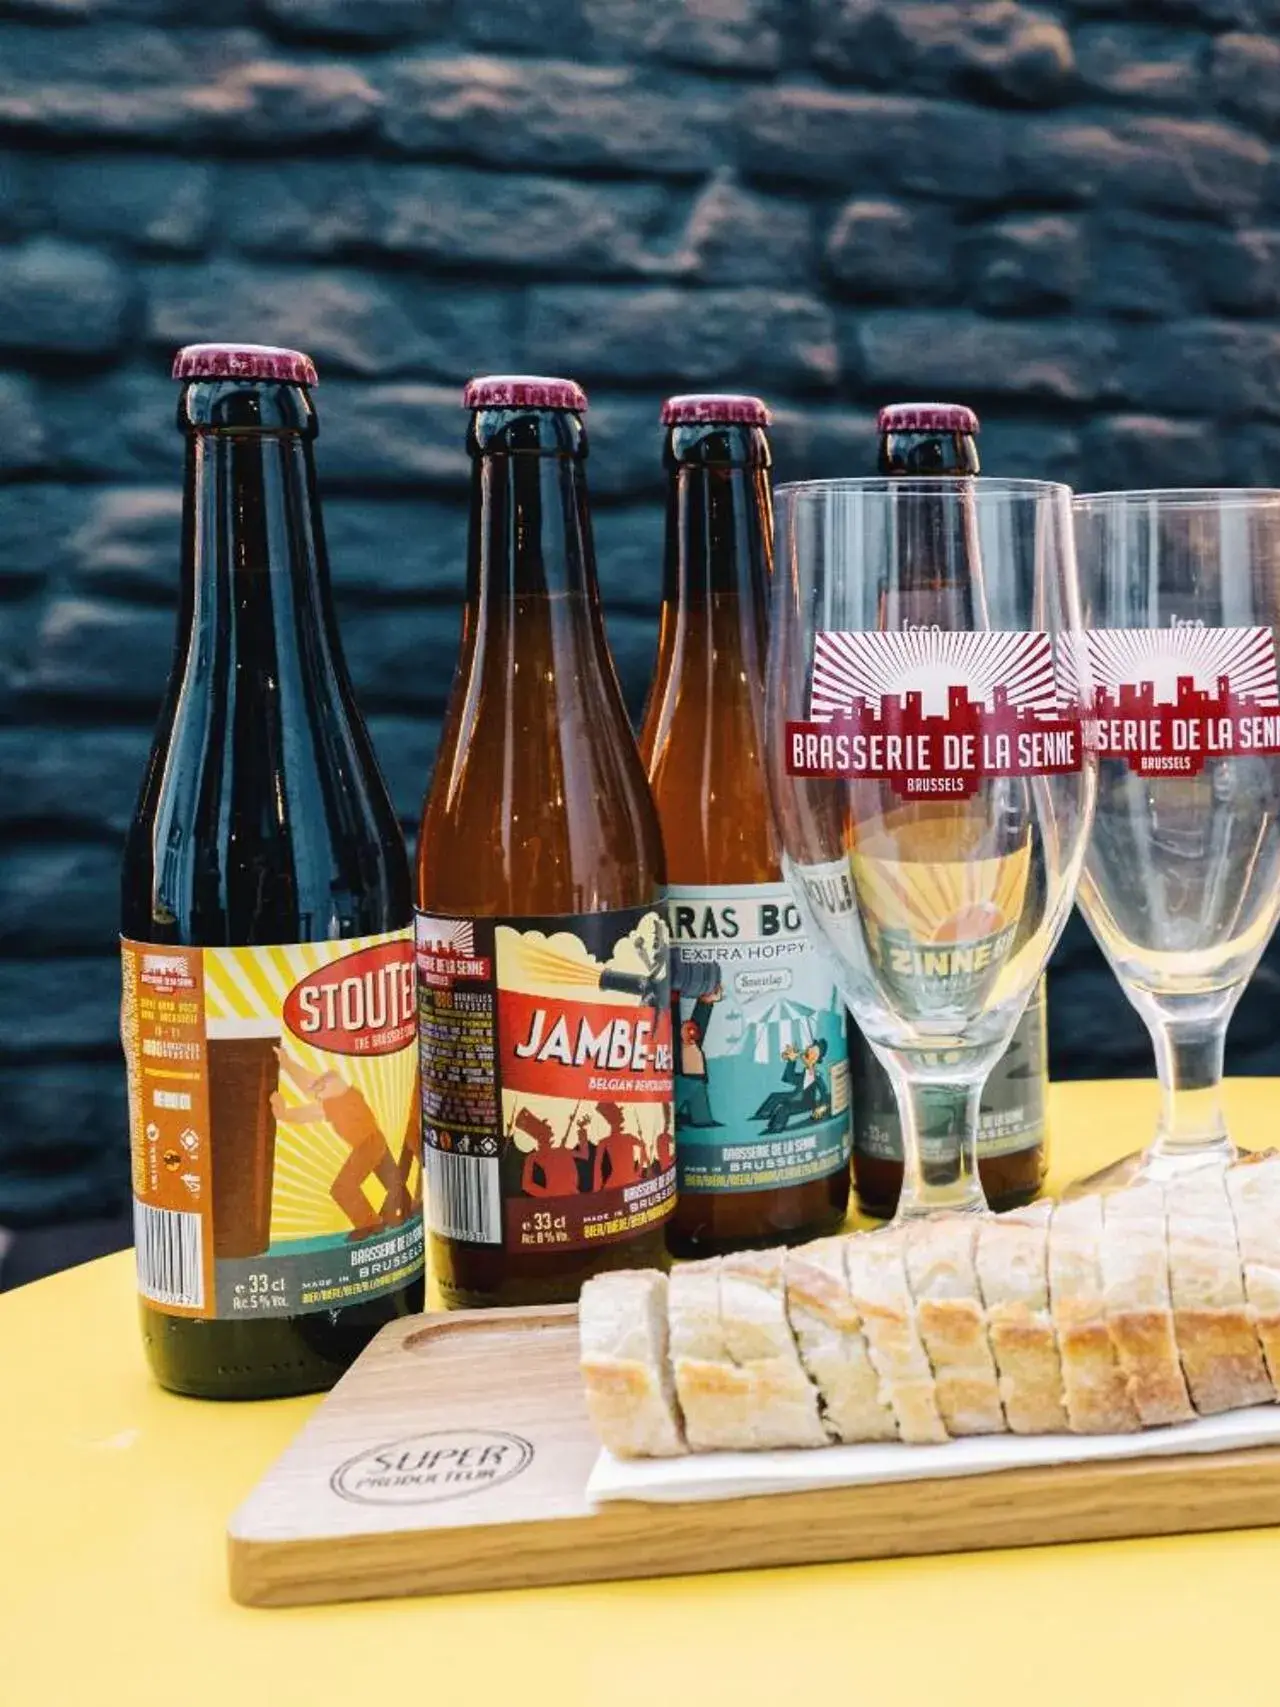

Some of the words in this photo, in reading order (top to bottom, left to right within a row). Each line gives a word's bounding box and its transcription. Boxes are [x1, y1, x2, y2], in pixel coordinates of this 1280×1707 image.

[1172, 718, 1201, 751] DE
[1207, 717, 1233, 750] LA
[792, 734, 931, 771] BRASSERIE
[943, 734, 976, 770] DE
[984, 734, 1010, 769] LA
[1018, 730, 1075, 768] SENNE
[1141, 755, 1191, 770] BRUSSELS
[907, 776, 964, 792] BRUSSELS
[682, 948, 743, 961] EXTRA
[748, 943, 805, 960] HOPPY
[588, 1077, 632, 1091] BELGIAN
[729, 1150, 814, 1172] BRUSSELS
[534, 1212, 551, 1230] 33
[360, 1242, 424, 1278] BRUSSELS
[249, 1274, 269, 1292] 33
[271, 1278, 285, 1291] cl
[366, 1444, 509, 1474] SUPER
[355, 1469, 496, 1490] PRODUCTEUR
